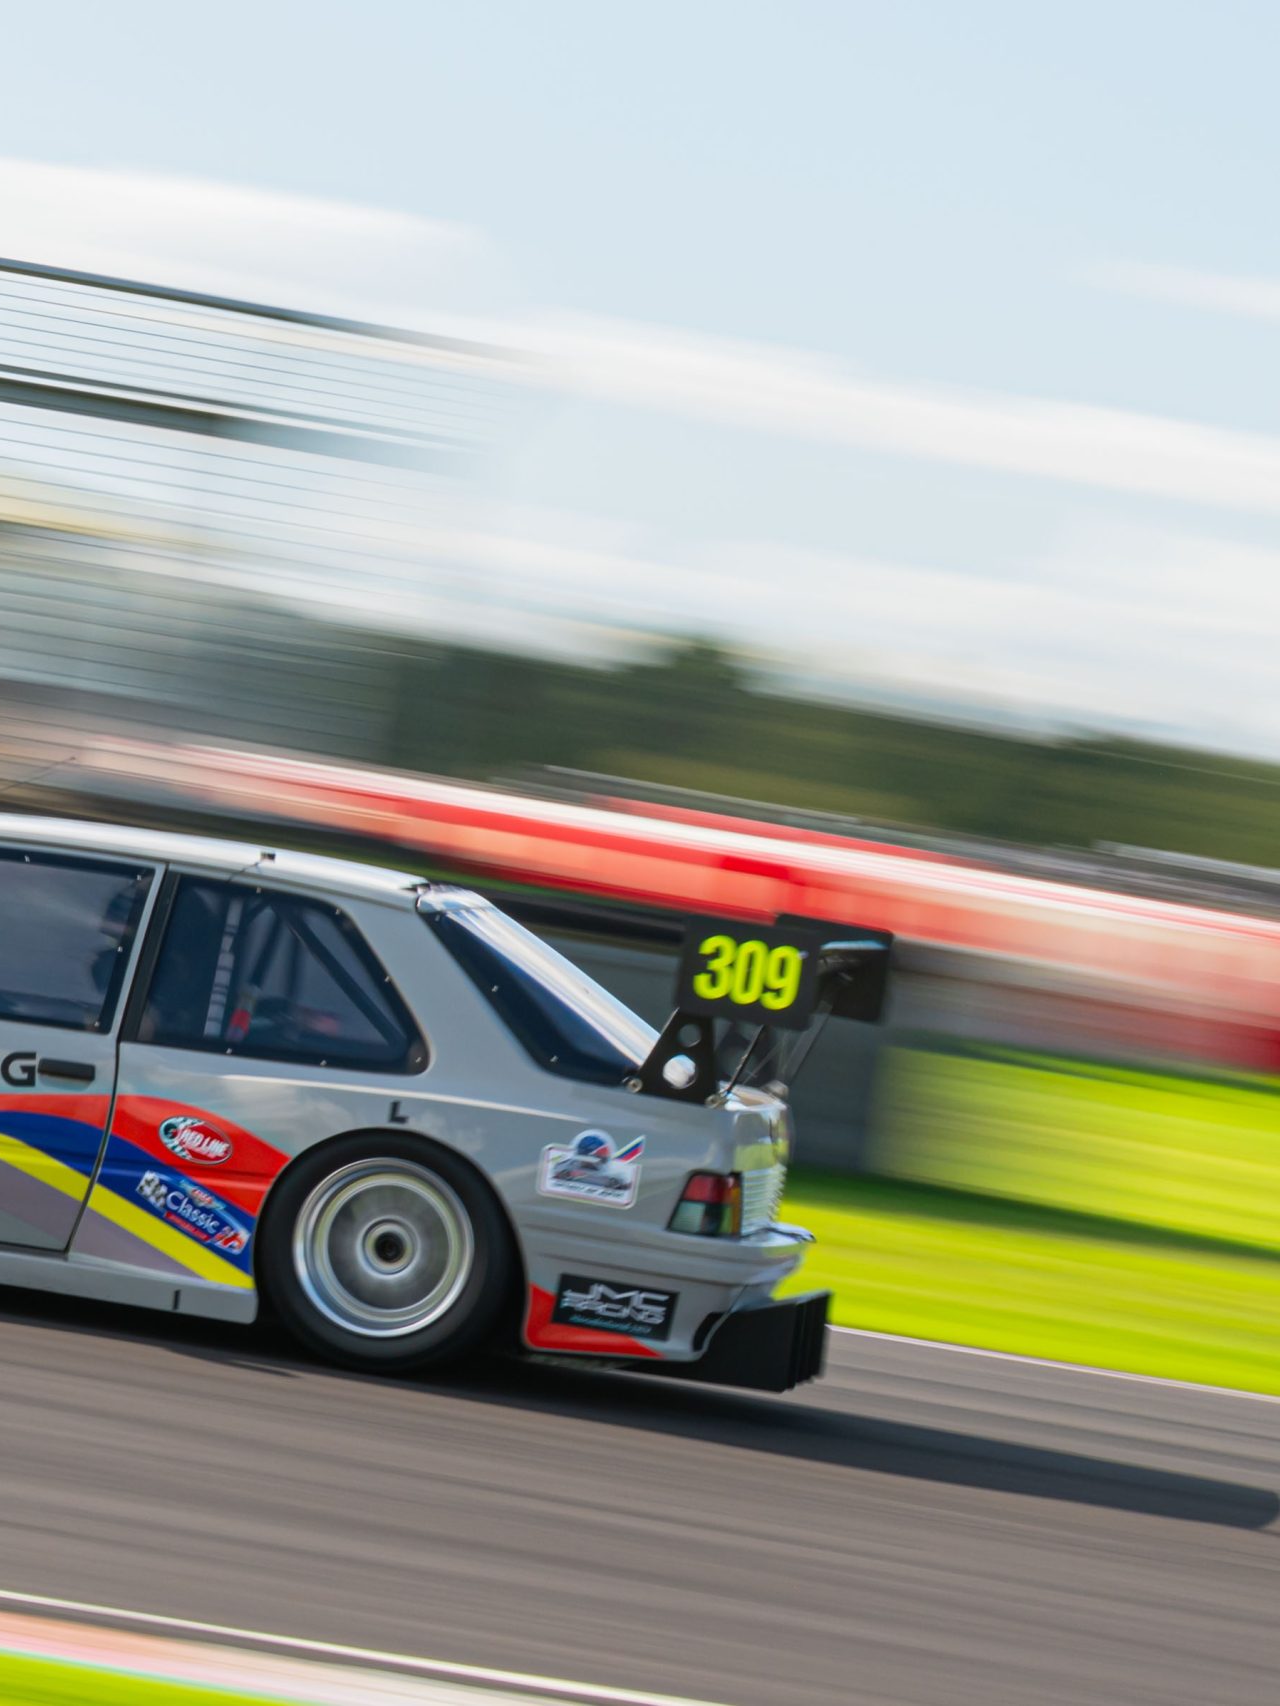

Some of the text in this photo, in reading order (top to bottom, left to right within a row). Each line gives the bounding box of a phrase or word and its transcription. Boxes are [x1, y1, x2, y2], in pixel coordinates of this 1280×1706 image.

[693, 935, 803, 1010] 309
[166, 1191, 220, 1234] Classic
[562, 1283, 670, 1312] JMC
